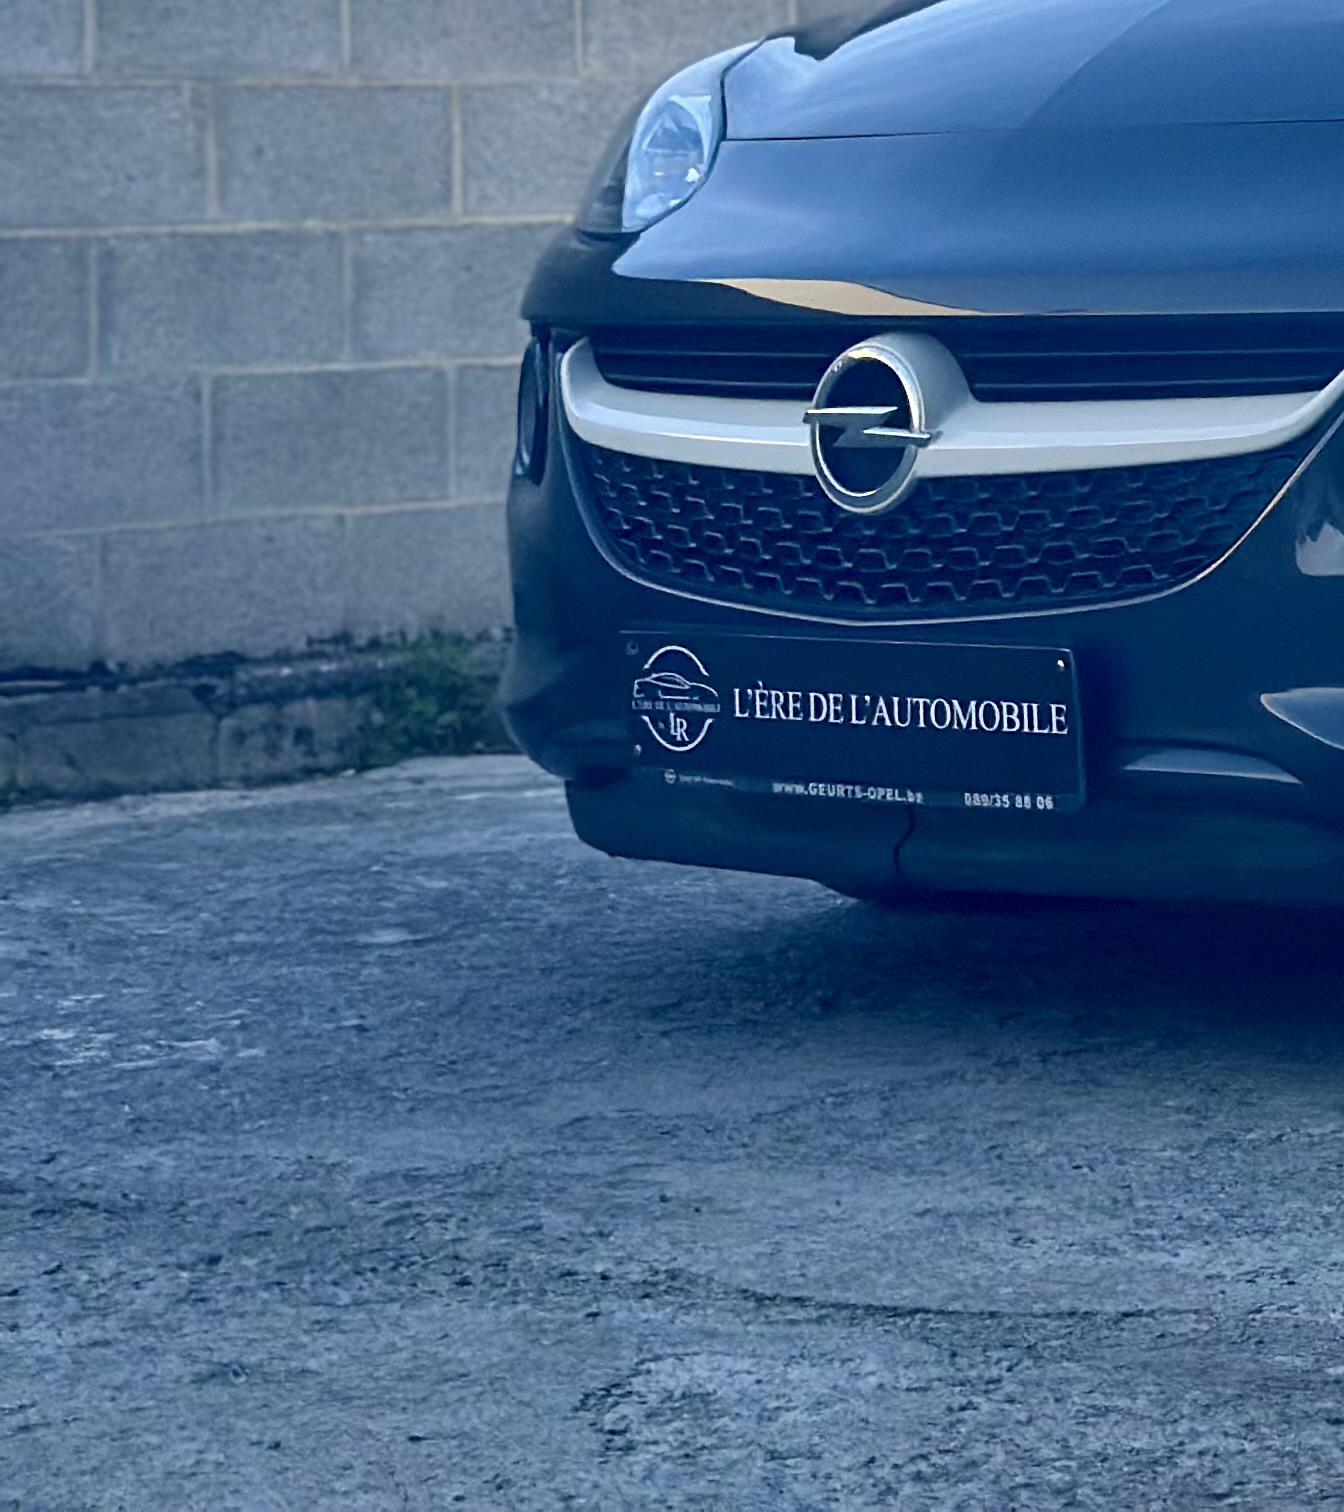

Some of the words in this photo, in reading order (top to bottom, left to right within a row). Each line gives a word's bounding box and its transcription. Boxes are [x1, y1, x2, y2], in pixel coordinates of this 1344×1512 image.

[669, 712, 691, 742] LR
[733, 680, 803, 722] L'ÈRE
[808, 692, 844, 724] DE
[850, 694, 1070, 735] L'AUTOMOBILE
